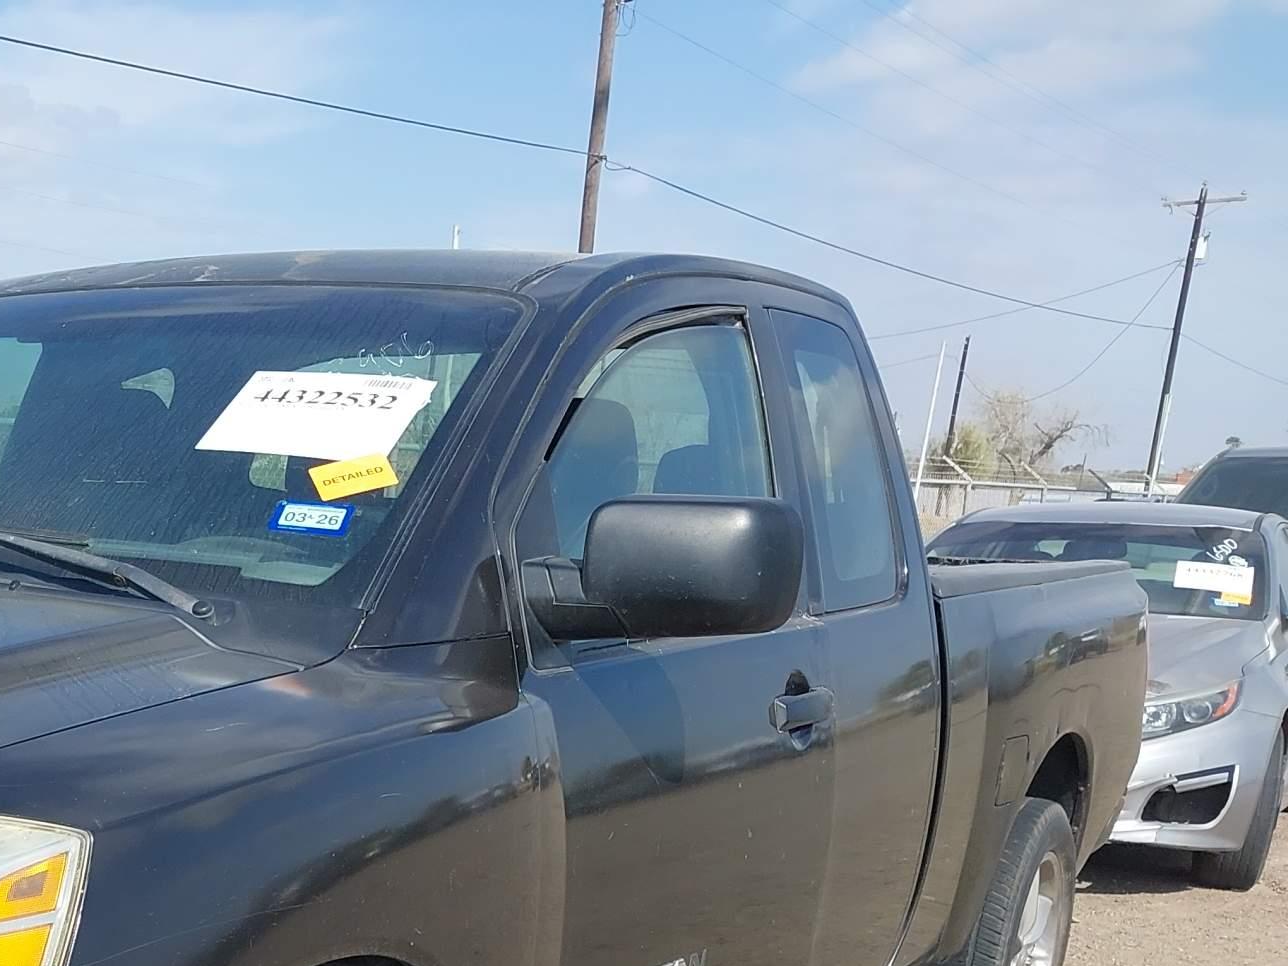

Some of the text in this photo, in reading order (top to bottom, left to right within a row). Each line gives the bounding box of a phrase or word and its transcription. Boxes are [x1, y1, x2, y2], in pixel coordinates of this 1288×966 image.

[254, 388, 398, 411] 44322532
[322, 465, 384, 487] DETAILED
[284, 511, 340, 526] 03 26
